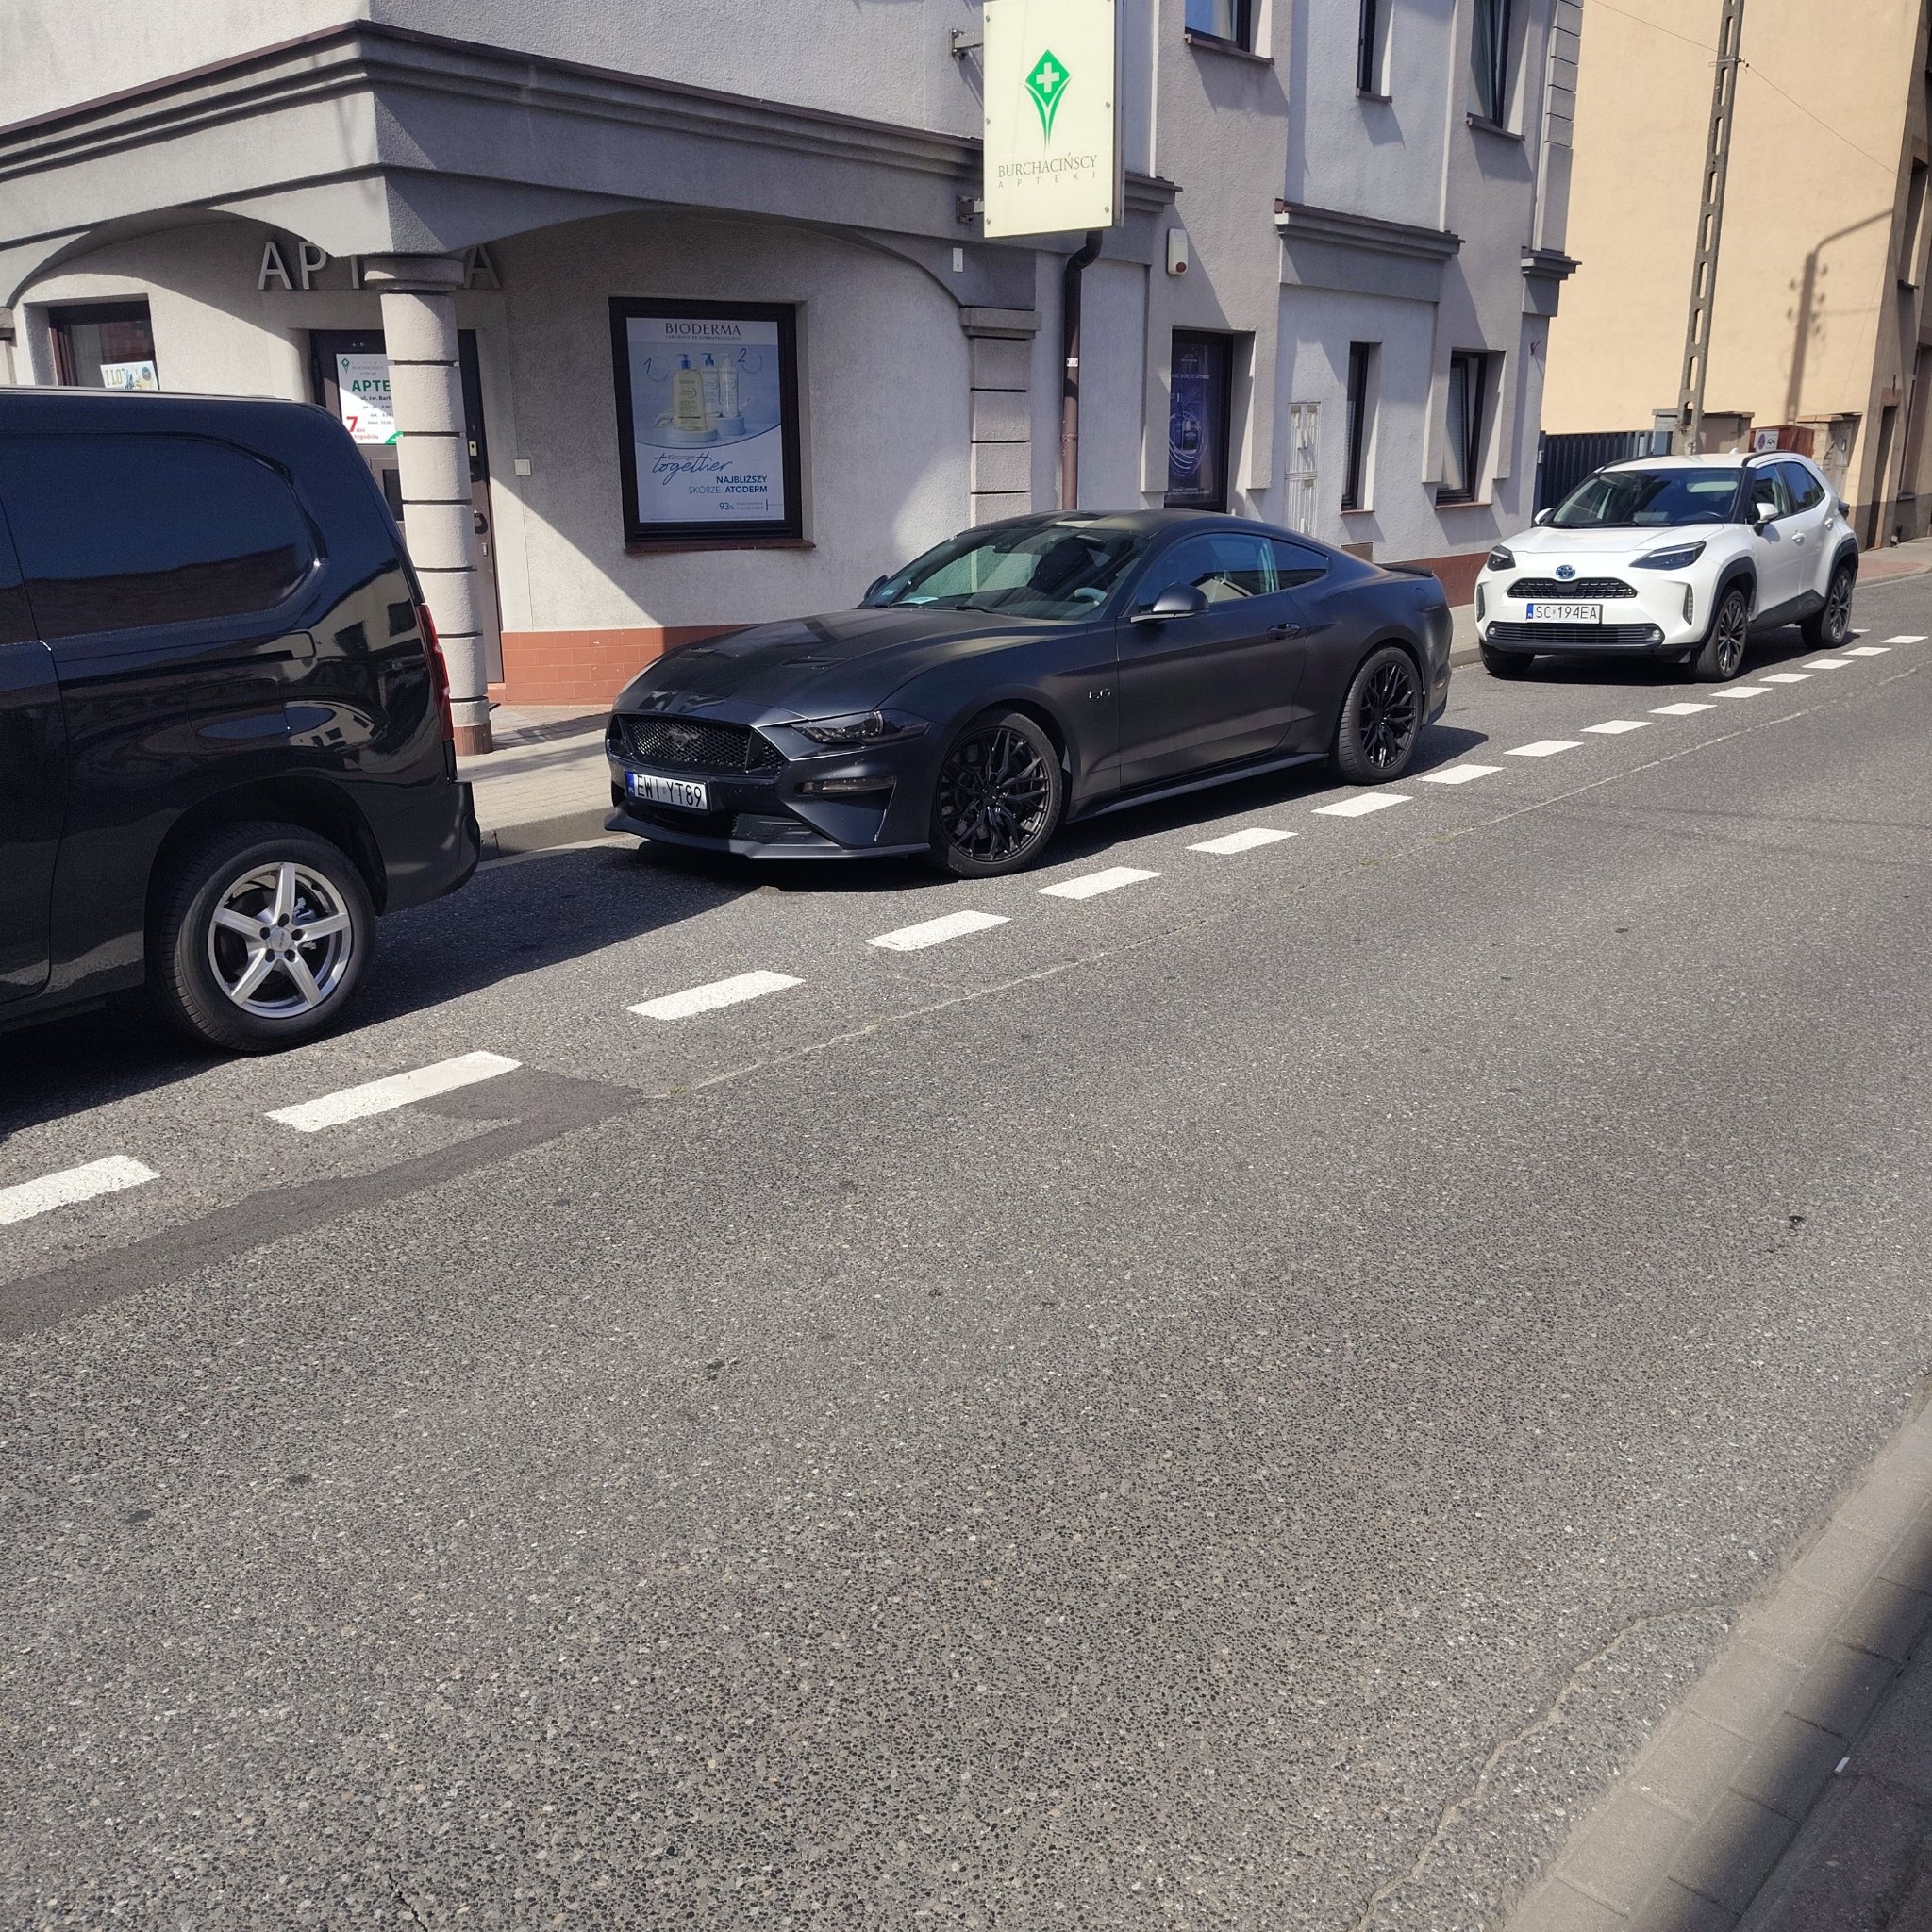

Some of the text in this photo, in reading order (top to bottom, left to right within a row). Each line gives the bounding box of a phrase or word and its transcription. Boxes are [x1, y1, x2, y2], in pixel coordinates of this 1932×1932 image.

[998, 152, 1098, 178] BURCHACIŃSCY
[998, 171, 1095, 189] APTEKI
[258, 242, 502, 290] APTA
[665, 322, 741, 336] BIODERMA
[737, 348, 747, 363] 2
[352, 380, 391, 392] APTE
[346, 416, 358, 432] 7
[652, 452, 733, 486] together
[716, 474, 768, 484] NAJBLIŻSZY
[688, 485, 768, 494] SKÓRZE ATODERM
[1536, 606, 1597, 619] SC 194EA
[637, 774, 702, 808] EWI YT89
